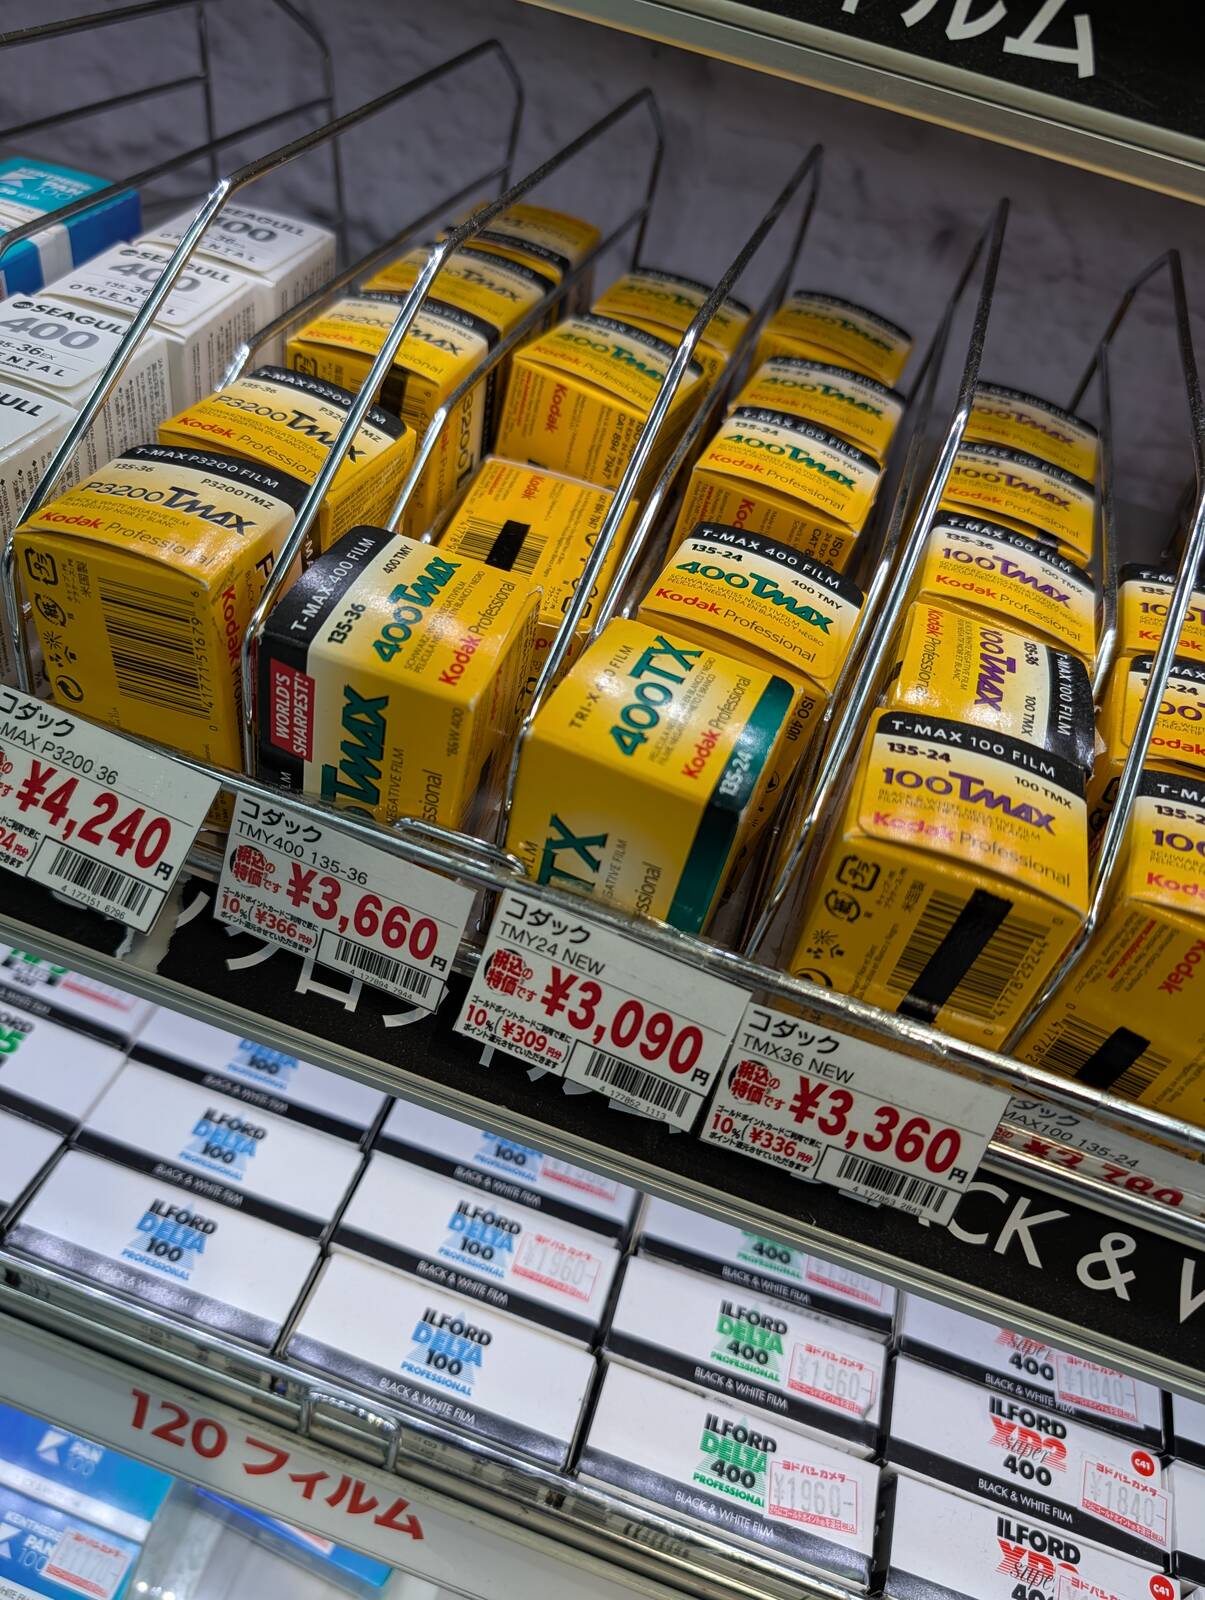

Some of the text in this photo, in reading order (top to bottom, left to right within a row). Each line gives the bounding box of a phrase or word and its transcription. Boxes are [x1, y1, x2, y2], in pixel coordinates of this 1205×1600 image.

[0, 317, 101, 350] 400
[30, 304, 128, 336] SEAGUL
[257, 369, 311, 387] T-MAX
[176, 415, 238, 440] Kodak
[544, 382, 568, 434] Kodak
[134, 447, 280, 490] T-MAX P3200 FILM
[707, 452, 847, 513] Kodak Professional
[37, 511, 215, 567] Kodak Professional
[690, 542, 745, 563] 135-24
[701, 527, 841, 591] T-MAX 400 FILM
[947, 517, 1075, 574] T-MAX 100 FILM
[290, 537, 377, 632] T-MAX 400 FILM
[790, 578, 844, 612] 400 TMY
[220, 583, 242, 666] Kodak
[327, 603, 366, 645] 135-36
[655, 587, 818, 664] Kodak Professional
[926, 607, 945, 637] Kodak
[935, 573, 1083, 643] Kodak Professional
[437, 579, 517, 687] Kodak Professional
[275, 671, 293, 741] WORLD'S
[568, 643, 633, 731] TRI-X FILM
[609, 635, 705, 757] 400TX
[799, 695, 818, 720] ISO
[1054, 651, 1075, 737] T-MAX 100 FILM
[0, 691, 76, 738] コダック
[681, 673, 752, 779] Kodak Professional
[40, 739, 120, 786] P3200 36
[886, 741, 953, 765] 135-24
[891, 719, 1057, 779] T-MAX 100 FILM
[717, 748, 756, 799] 135-24
[1014, 774, 1074, 811] 100 TMX
[15, 758, 175, 882] ¥4,240 円
[240, 798, 323, 844] コダック
[235, 844, 276, 874] 税込の
[236, 818, 369, 886] TMY400 135-36
[872, 810, 956, 842] Kodak
[958, 830, 1072, 889] Professional
[233, 861, 283, 894] 特価です
[221, 893, 249, 920] 10%
[285, 861, 448, 972] ¥3,660 円
[504, 896, 592, 945] コダック
[491, 948, 534, 981] 税込の
[499, 919, 607, 977] TMY24 NEW
[485, 966, 538, 1003] 特価です
[465, 1003, 495, 1032] 10%
[539, 965, 711, 1087] ¥3,090 円
[748, 1009, 841, 1055] コダック
[736, 1059, 781, 1090] 税込の
[741, 1031, 856, 1086] TMX36 NEW
[729, 1078, 786, 1111] 特価です
[711, 1112, 742, 1140] 10%
[788, 1074, 969, 1185] ¥3,360 円
[1077, 1138, 1140, 1169] 135-24
[146, 1198, 218, 1236] ILFORD
[455, 1200, 523, 1236] ILFORD
[145, 1236, 184, 1263] 100
[459, 1235, 496, 1262] 100
[947, 1180, 1071, 1270] CK
[1075, 1230, 1138, 1303] &
[422, 1307, 493, 1348] ILFORD
[715, 1312, 784, 1355] DELTA
[719, 1299, 788, 1336] ILFORD
[410, 1319, 485, 1368] DELTA
[425, 1348, 465, 1376] 100
[726, 1339, 770, 1367] 400
[400, 1359, 474, 1397] PROFESSIONAL
[1007, 1350, 1056, 1382] 400
[703, 1412, 778, 1454] ILFORD
[988, 1395, 1068, 1440] ILFORD
[130, 1387, 426, 1541] 120 フィルム
[699, 1430, 768, 1474] DELTA
[709, 1457, 757, 1490] 400
[1001, 1452, 1053, 1487] 400
[1133, 1456, 1152, 1471] C41
[674, 1489, 707, 1513] BLACK
[717, 1506, 753, 1529] WHITE
[752, 1517, 776, 1540] FILM
[977, 1476, 1009, 1499] BLACK
[1009, 1489, 1018, 1502] &
[1018, 1493, 1052, 1516] WHITE
[1051, 1506, 1074, 1525] FILM
[996, 1514, 1082, 1566] ILFORD
[1151, 1580, 1172, 1597] C41
